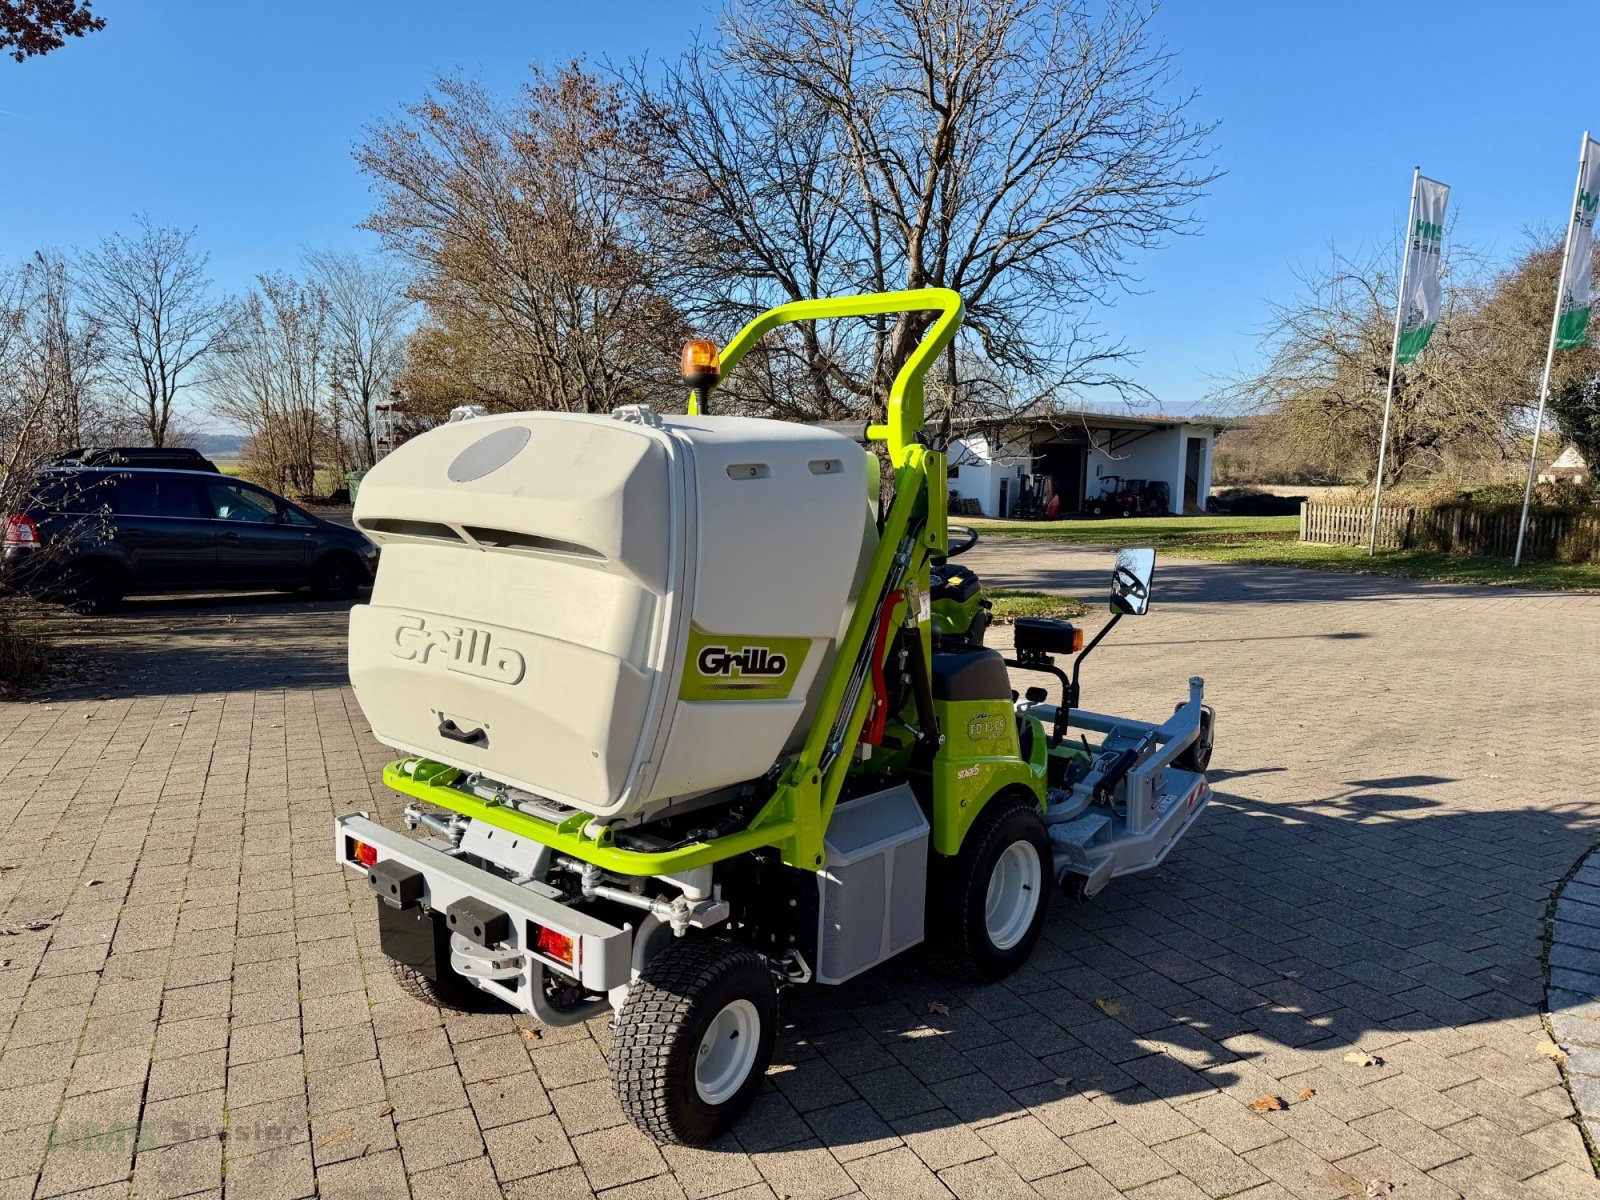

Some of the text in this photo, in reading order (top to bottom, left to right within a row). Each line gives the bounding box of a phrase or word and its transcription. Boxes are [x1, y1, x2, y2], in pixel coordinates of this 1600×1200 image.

[1577, 187, 1600, 213] HM
[389, 614, 526, 686] Grillo
[698, 646, 787, 676] Grillo
